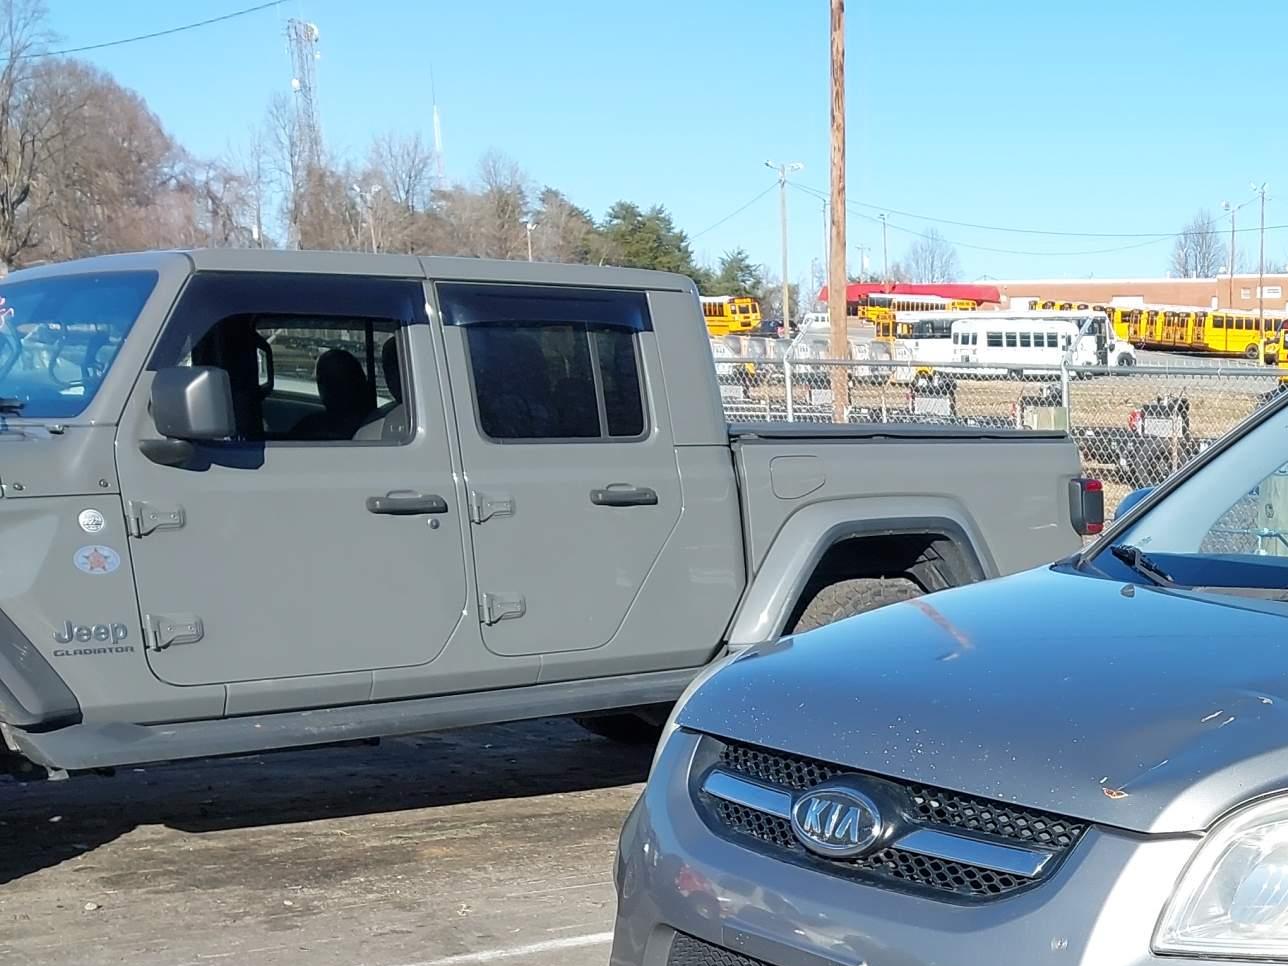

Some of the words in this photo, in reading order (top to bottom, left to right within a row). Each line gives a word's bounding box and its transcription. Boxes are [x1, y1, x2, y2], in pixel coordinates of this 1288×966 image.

[53, 620, 128, 645] Jeep
[53, 645, 134, 657] GLADIATOR
[803, 798, 861, 843] KIA
